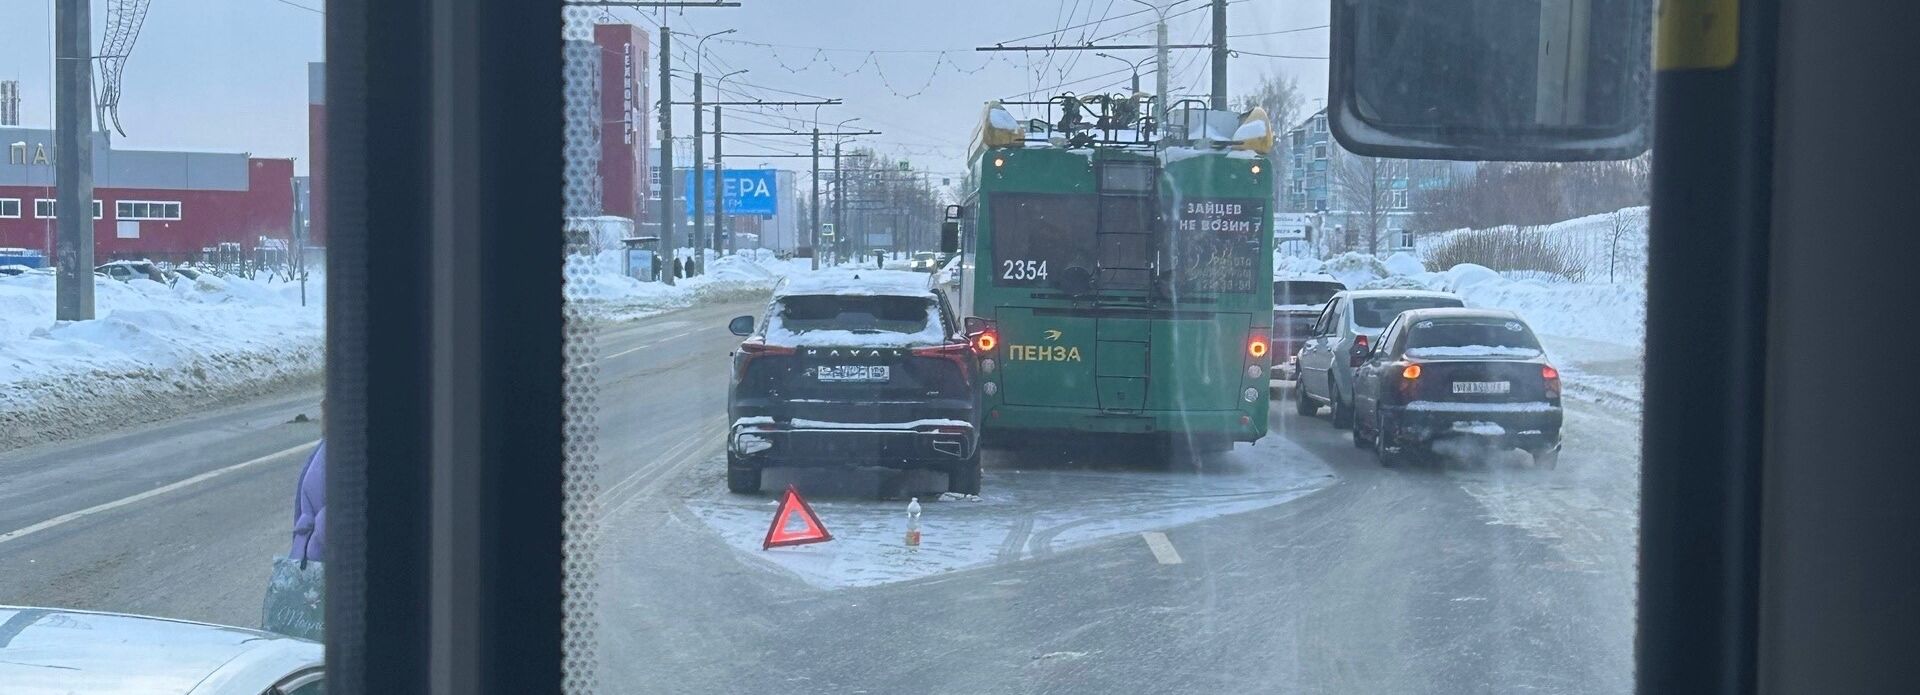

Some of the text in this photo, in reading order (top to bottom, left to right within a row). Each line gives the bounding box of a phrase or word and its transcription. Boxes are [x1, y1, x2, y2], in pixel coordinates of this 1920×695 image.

[10, 141, 57, 165] ПА
[1187, 201, 1242, 216] ЗАЙЦЕВ
[1179, 219, 1250, 232] НЕ ВОЗИМ
[1003, 259, 1048, 281] 2354
[1009, 344, 1081, 362] ПЕНЗА
